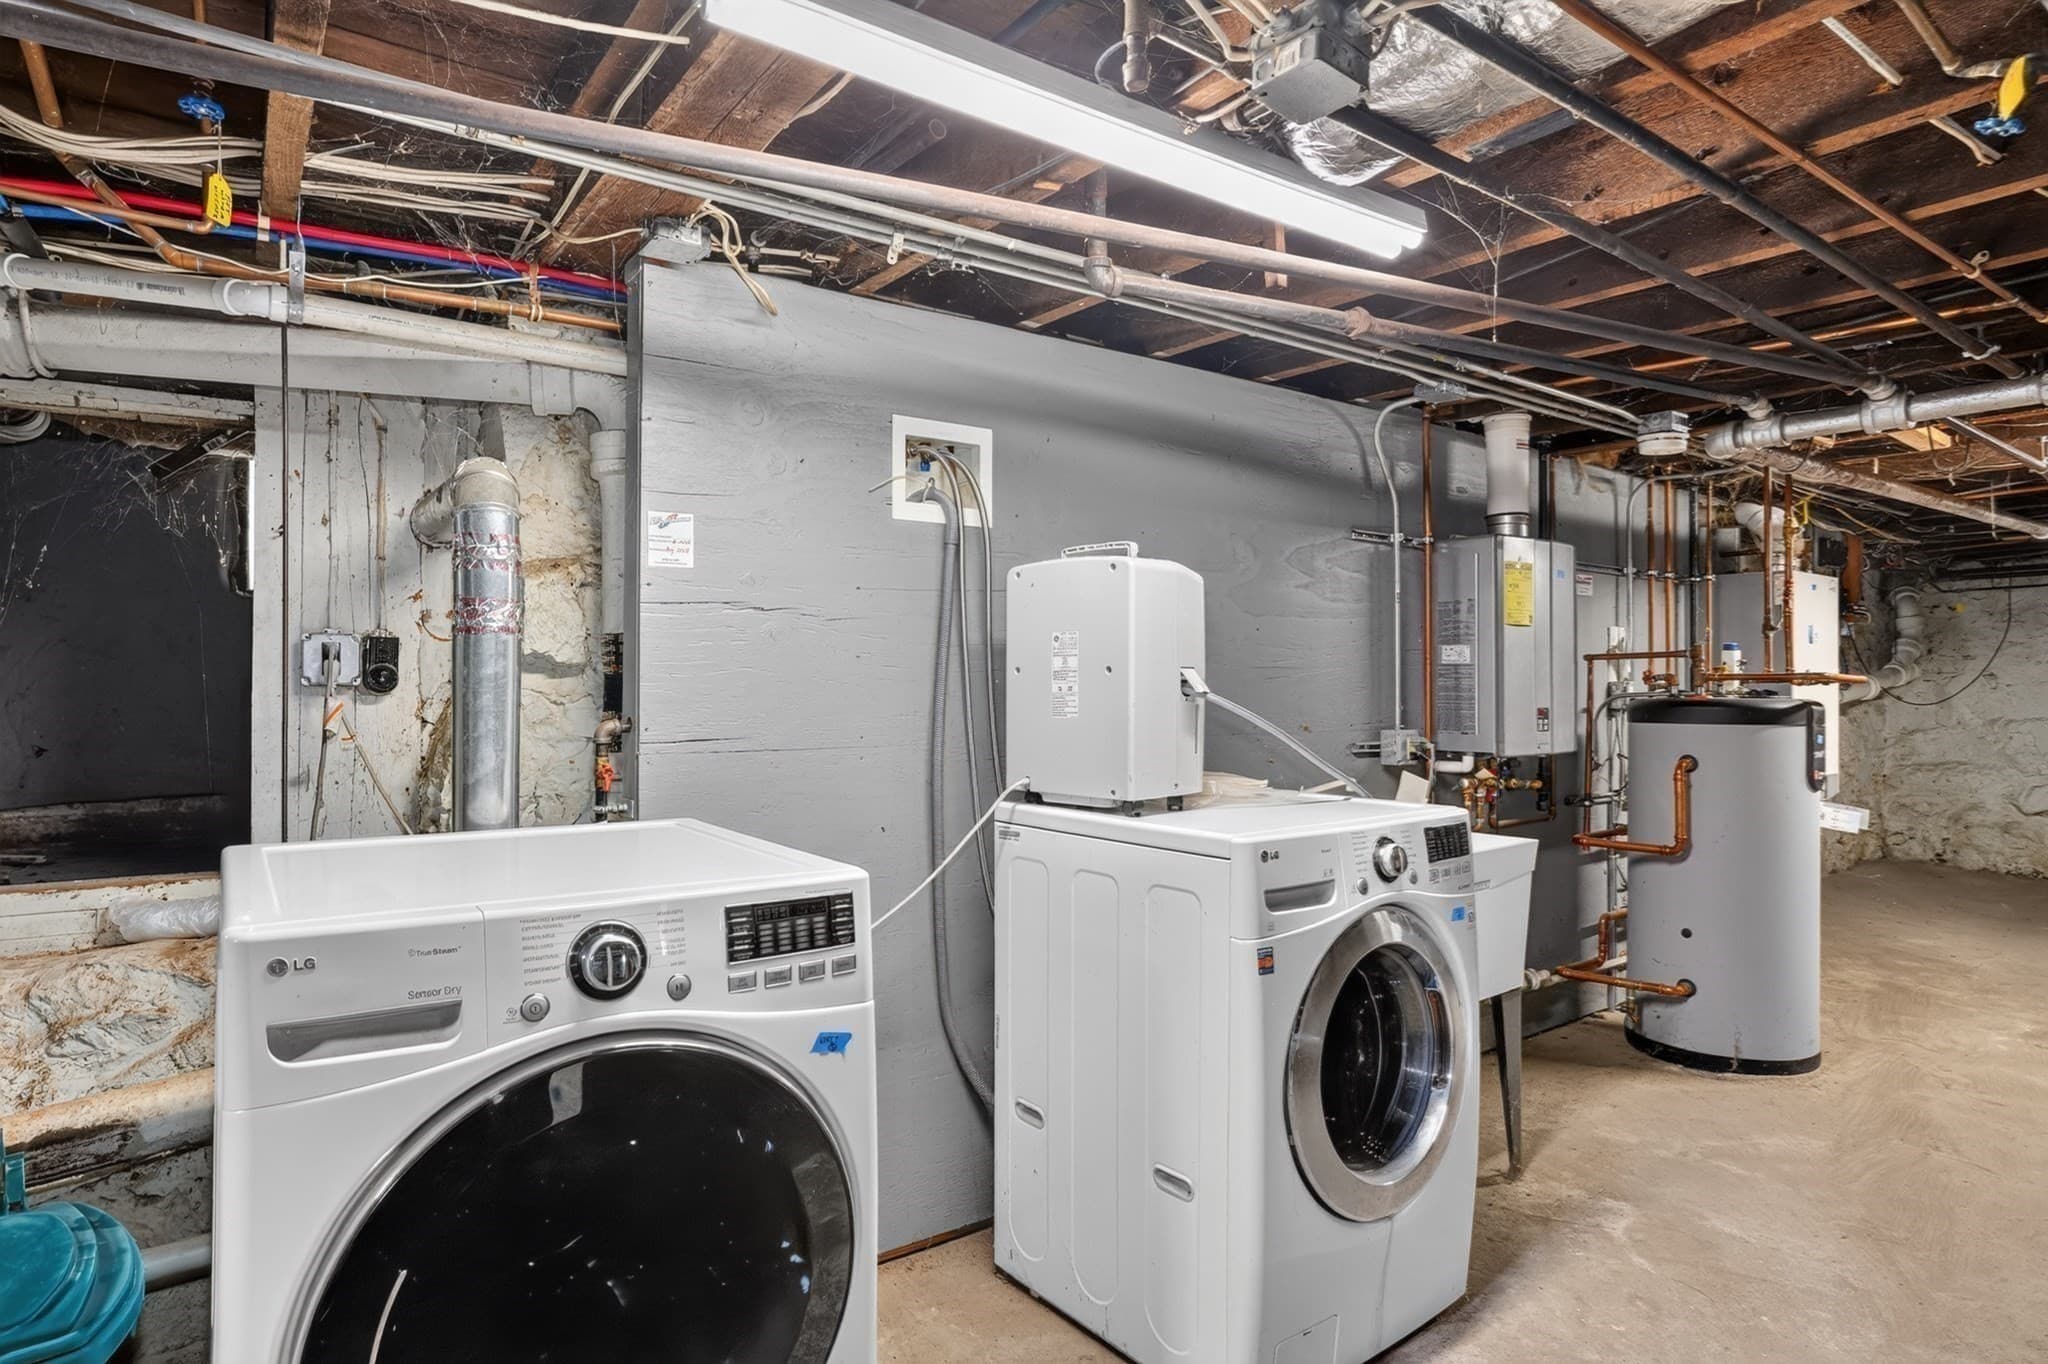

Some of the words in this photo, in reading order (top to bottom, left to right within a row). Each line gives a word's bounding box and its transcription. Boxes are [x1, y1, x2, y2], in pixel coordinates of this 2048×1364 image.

[1270, 850, 1280, 860] LG
[293, 957, 316, 971] LG
[407, 988, 442, 1000] Sensor
[444, 985, 462, 996] Dry
